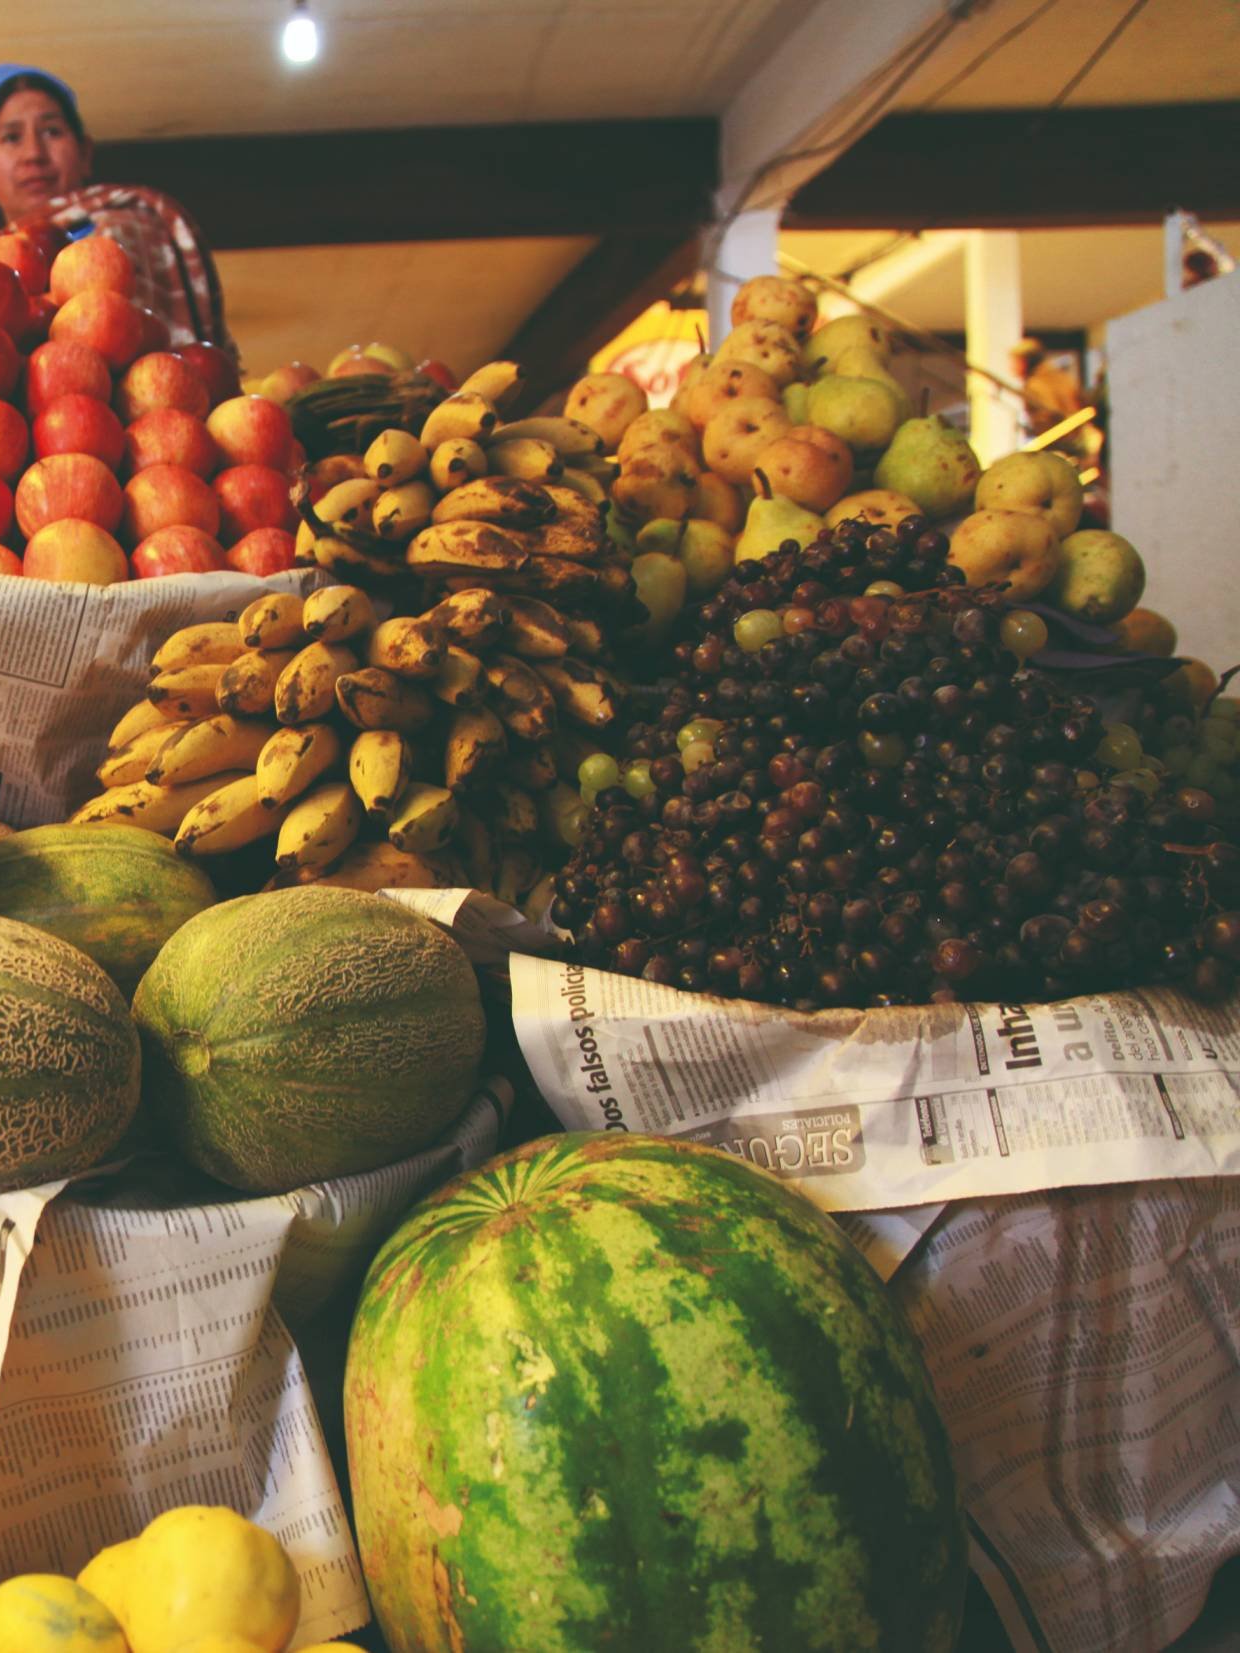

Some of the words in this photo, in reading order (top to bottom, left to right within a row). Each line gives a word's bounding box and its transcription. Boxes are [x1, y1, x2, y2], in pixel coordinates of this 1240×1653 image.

[575, 1025, 612, 1094] falsos
[1063, 1042, 1094, 1061] a
[1104, 1017, 1125, 1061] Delito.
[781, 1113, 851, 1131] POLICIALES
[711, 1128, 854, 1171] SEGUR
